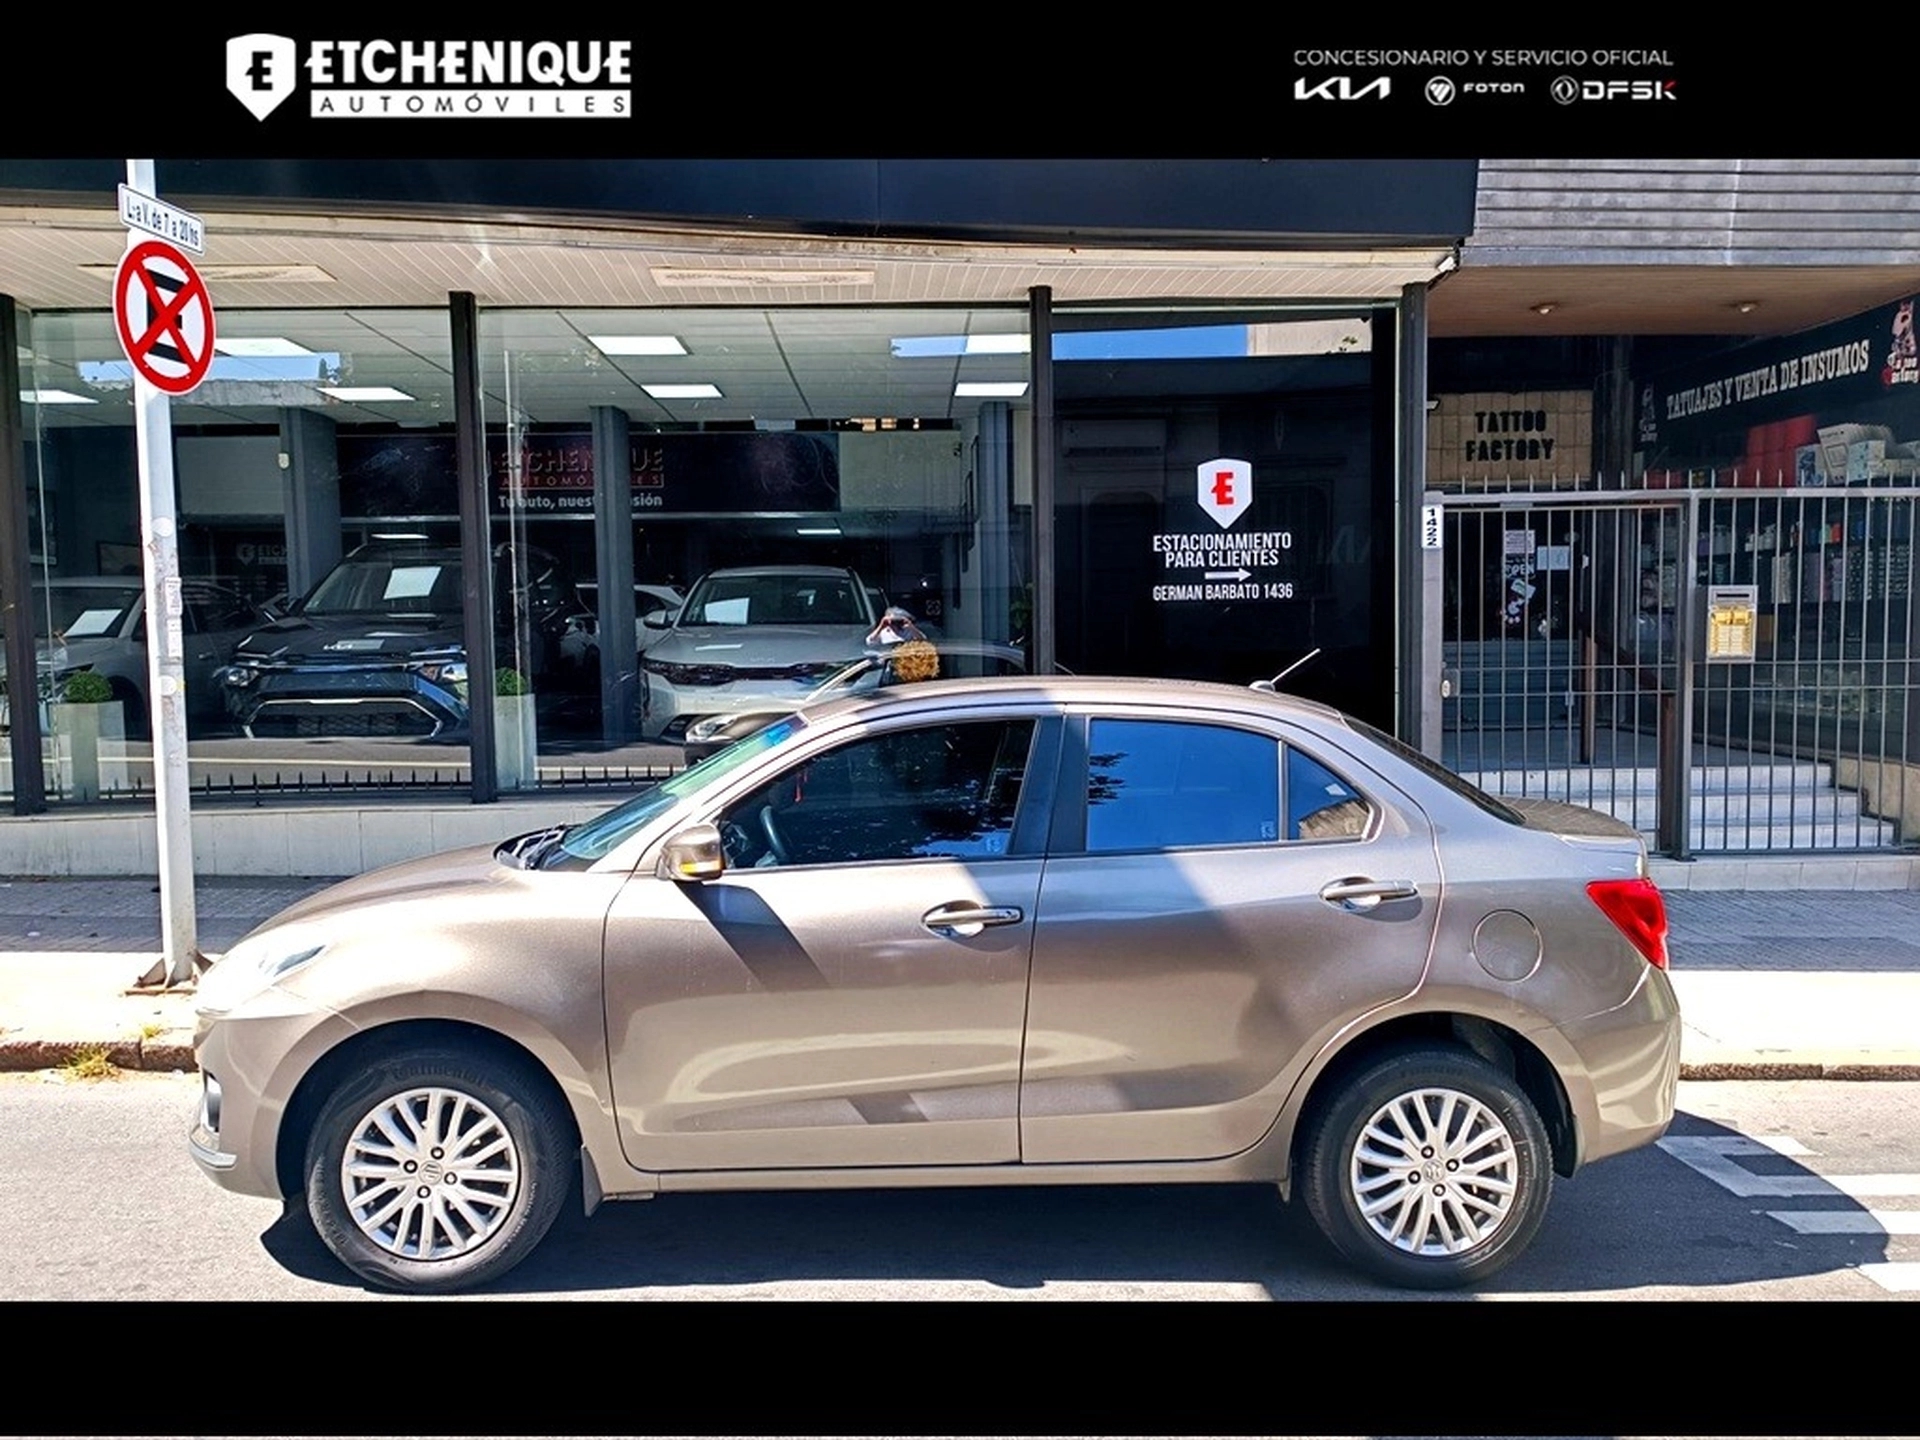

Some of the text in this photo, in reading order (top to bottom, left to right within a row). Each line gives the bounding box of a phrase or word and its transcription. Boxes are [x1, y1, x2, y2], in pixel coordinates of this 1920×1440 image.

[152, 207, 161, 230] de
[180, 220, 188, 242] 20
[1666, 338, 1870, 420] TATUAJES Y VENTA DE INSUMOS
[1475, 410, 1547, 434] TATTOO
[1466, 438, 1554, 462] FACTORY
[1426, 508, 1438, 547] 1422
[1153, 532, 1292, 552] ESTACIONAMIENTO
[1165, 549, 1279, 568] PARA CLIENTES
[1153, 582, 1293, 601] GERMAN BARBATO 1436
